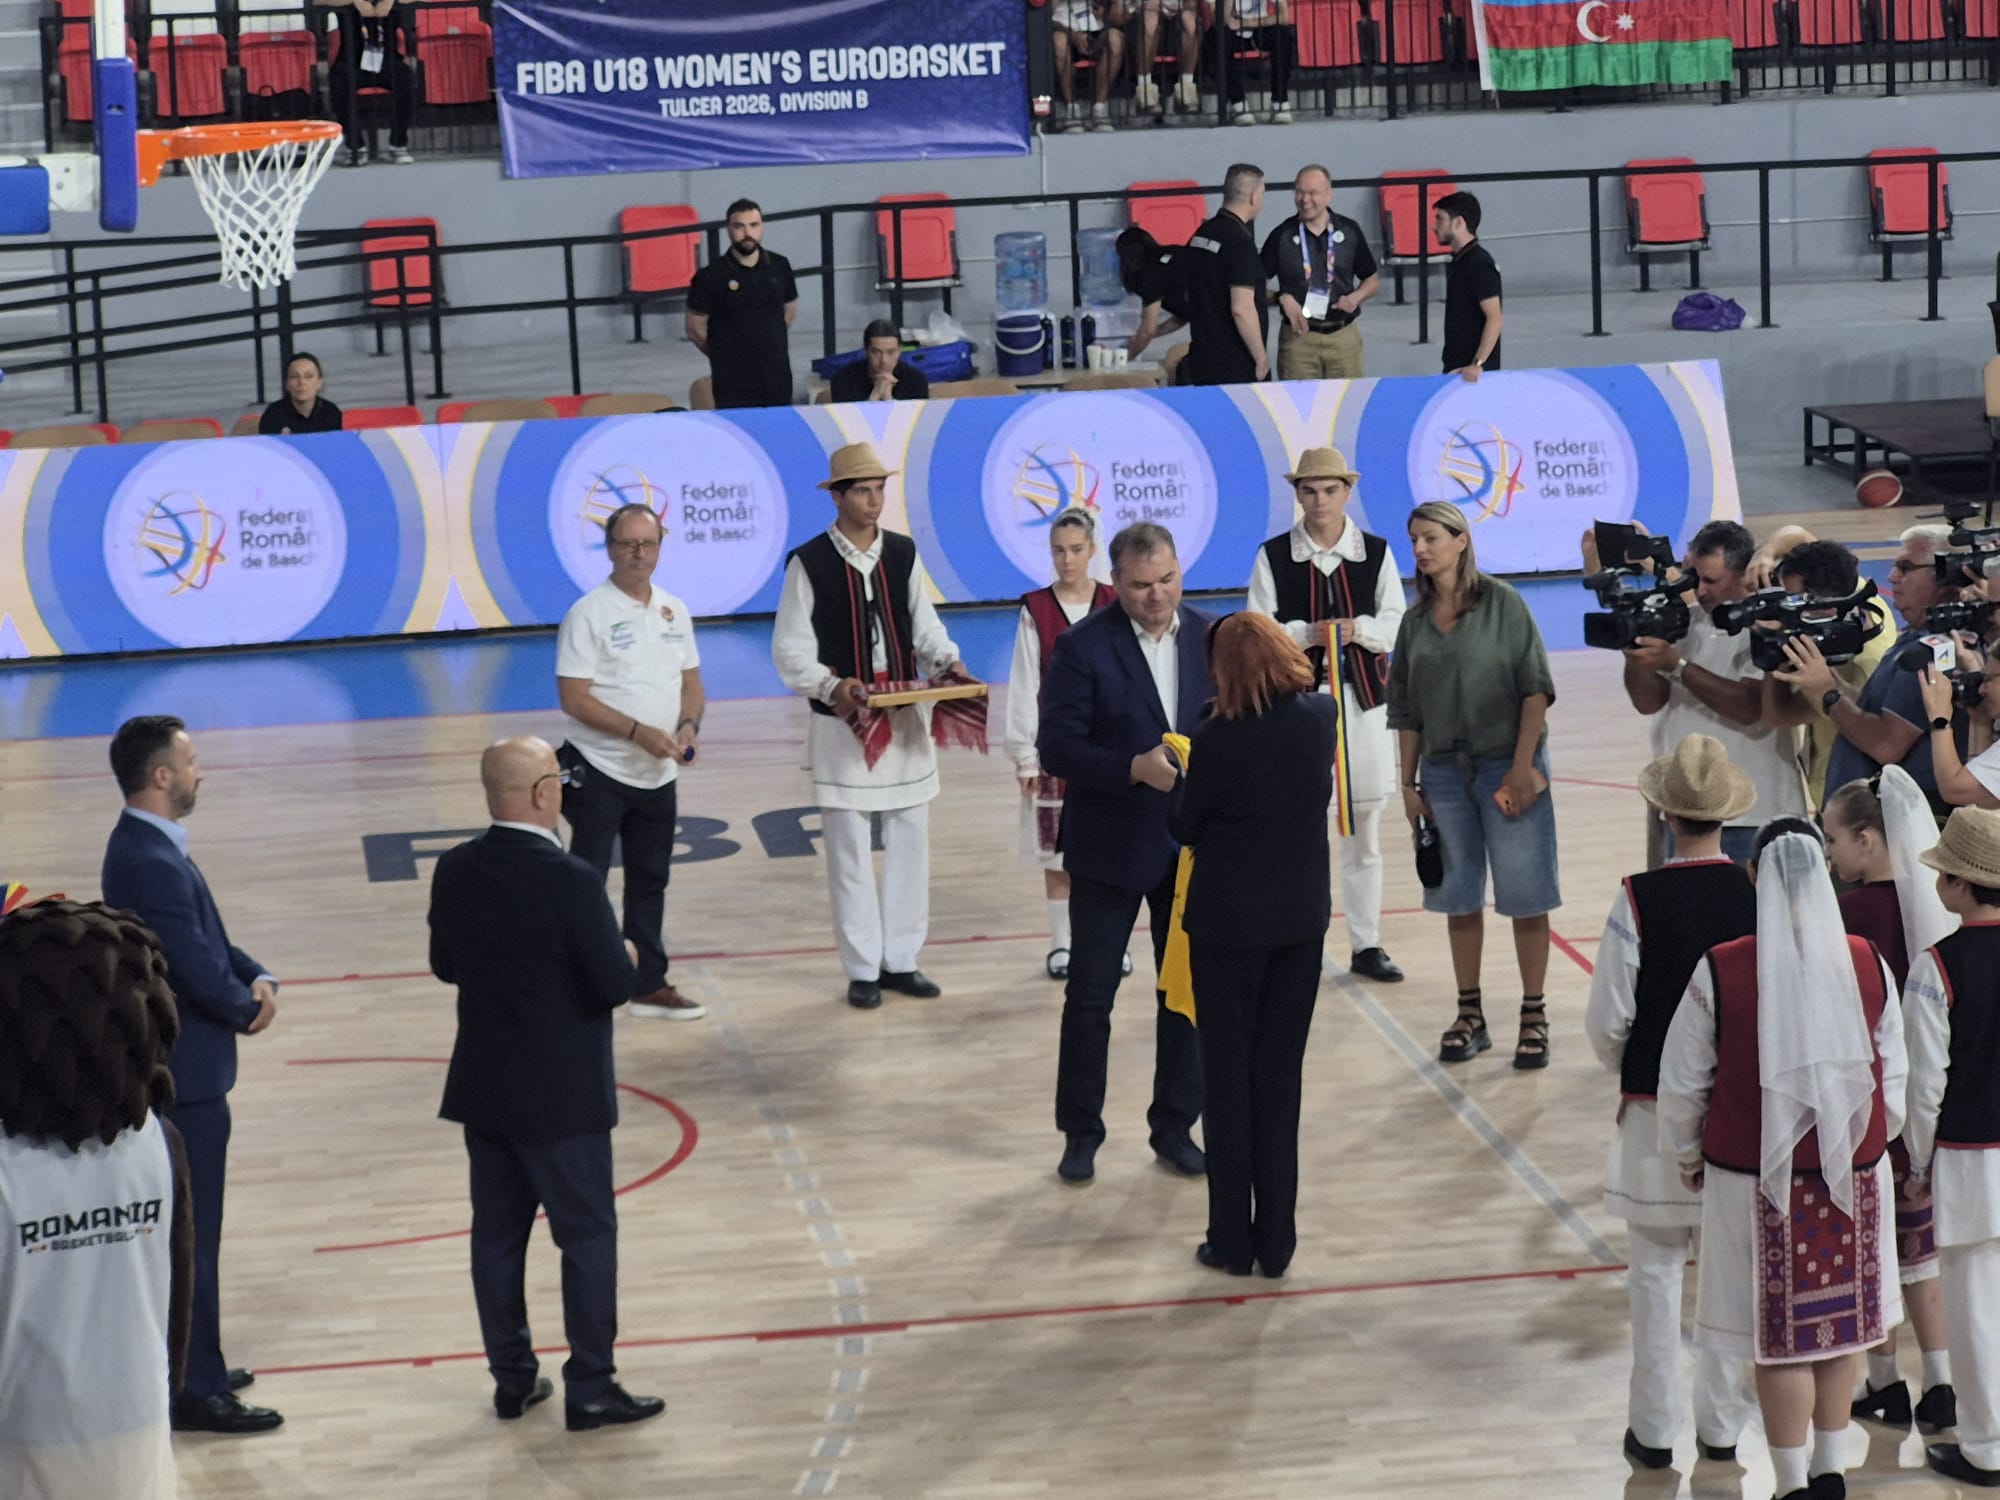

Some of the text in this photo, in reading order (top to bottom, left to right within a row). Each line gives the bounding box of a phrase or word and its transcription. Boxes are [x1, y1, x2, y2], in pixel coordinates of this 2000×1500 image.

[517, 42, 1006, 95] FIBA U18 WOMEN'S EUROBASKET
[658, 88, 869, 118] TULCEA 2026, DIVISION B
[1540, 482, 1560, 499] de
[1116, 505, 1137, 520] de
[685, 527, 705, 543] de
[240, 553, 262, 569] de
[18, 1198, 163, 1247] ROMANIA
